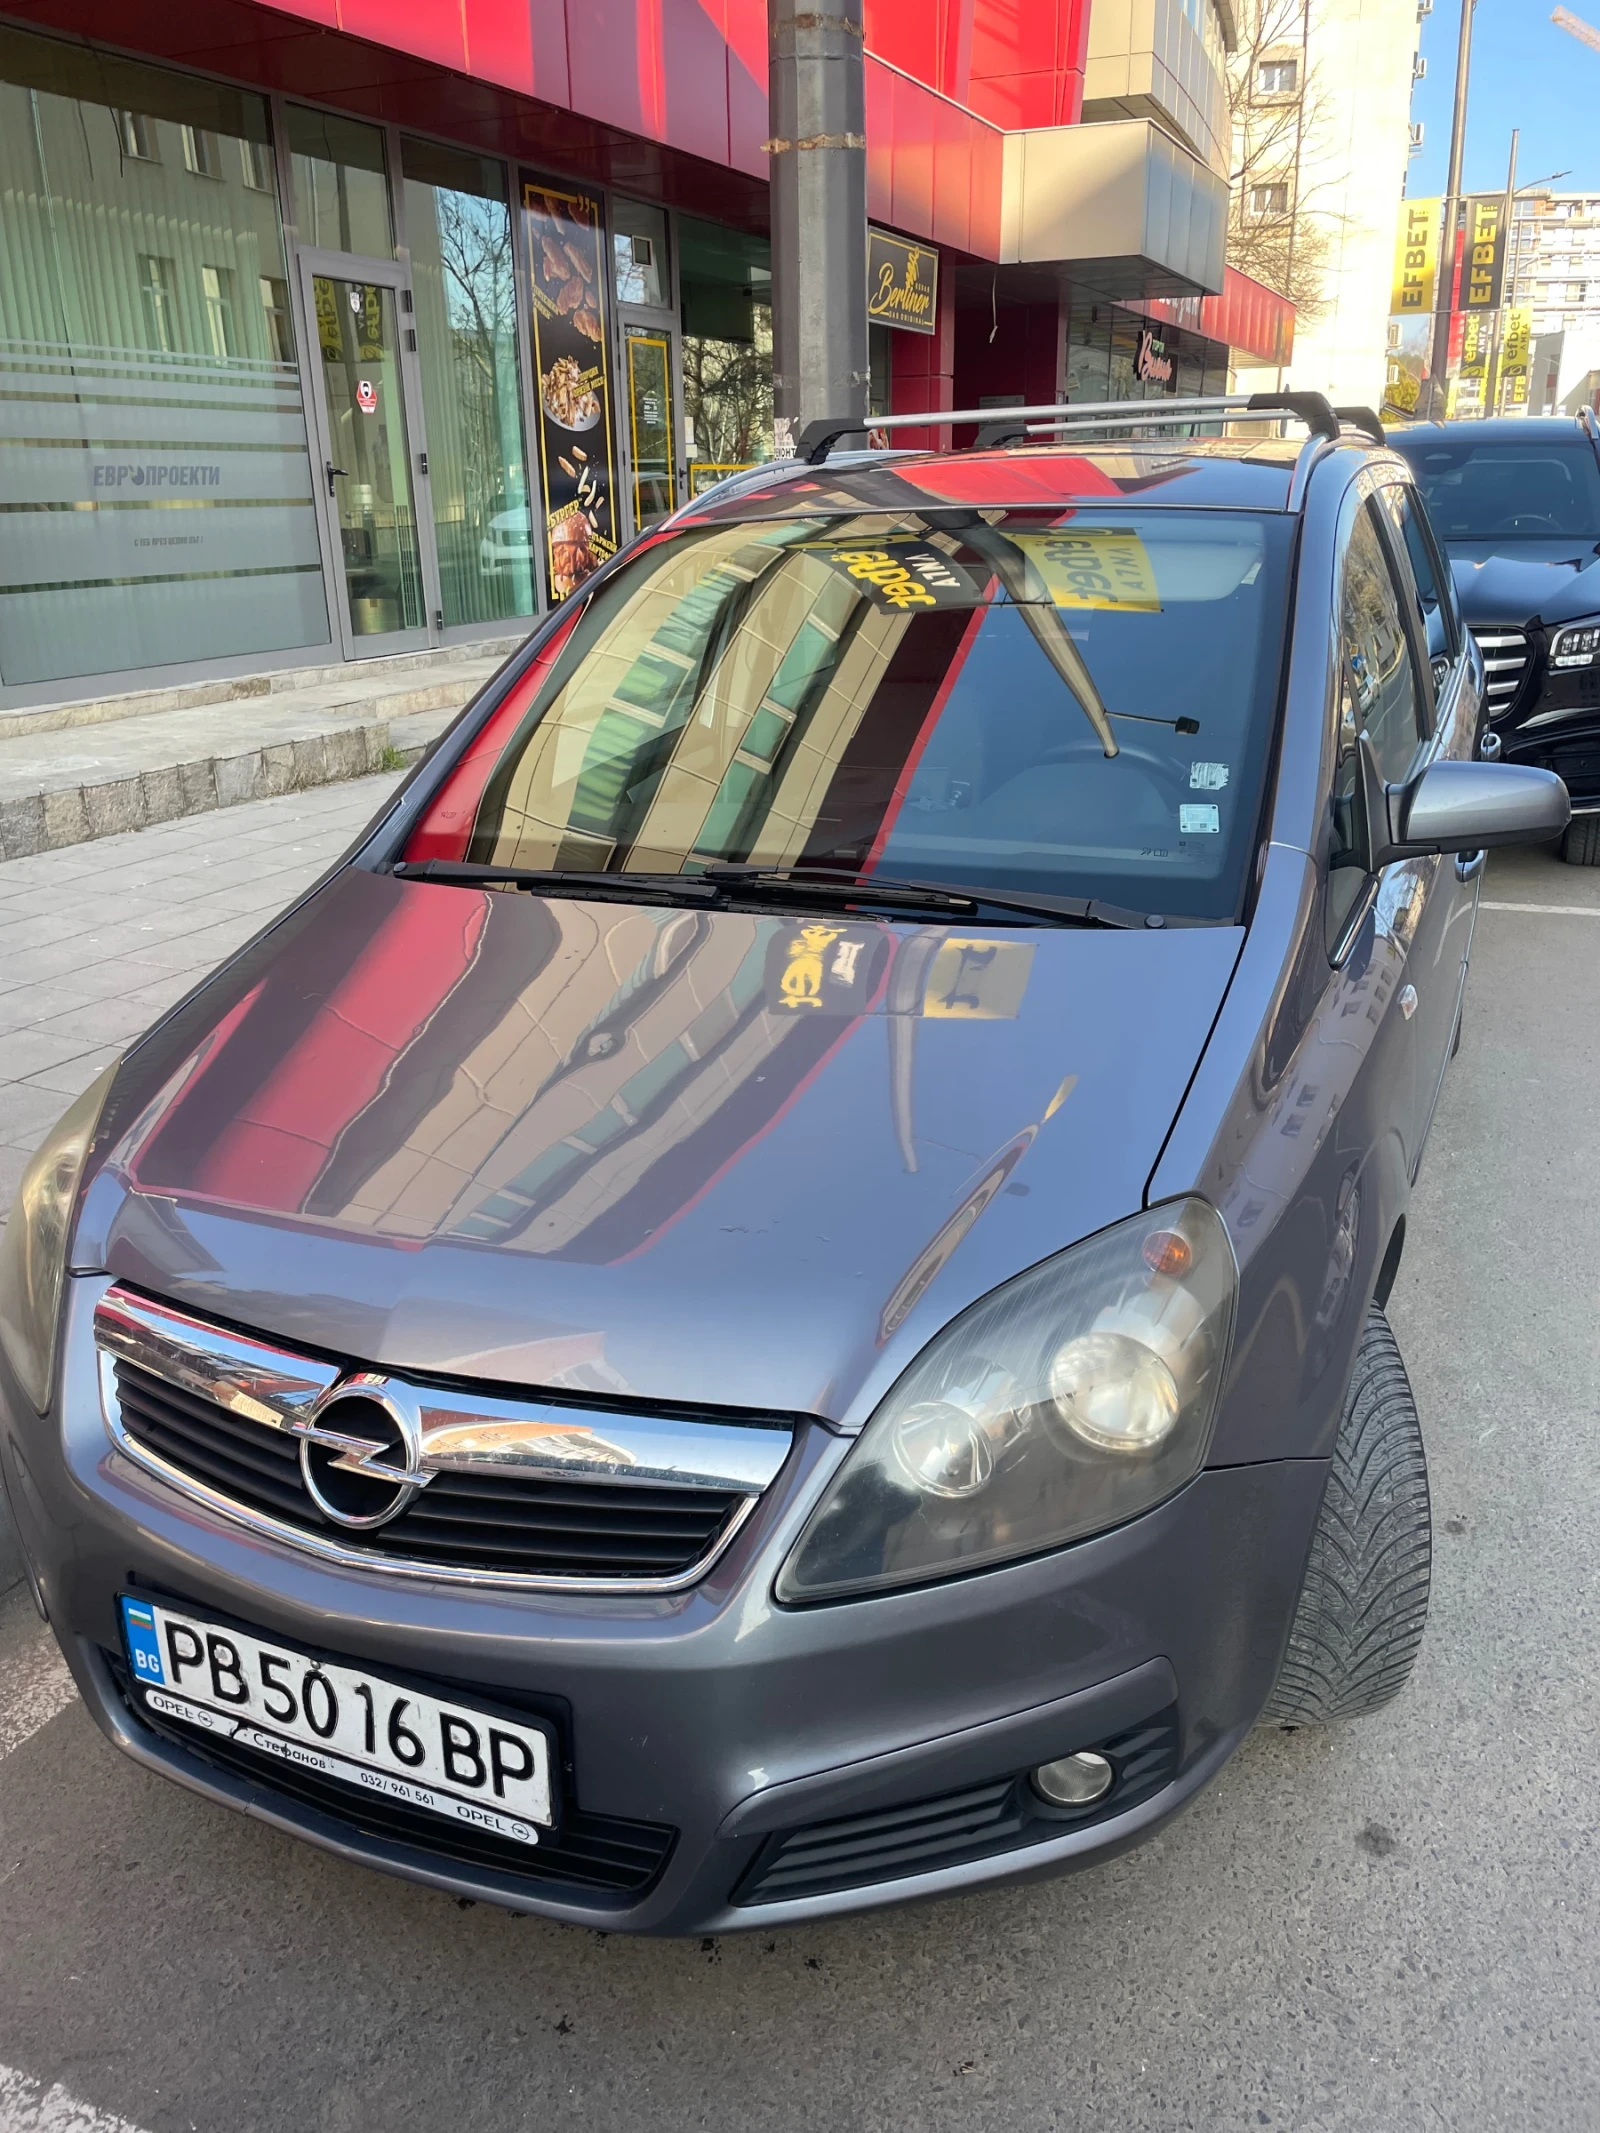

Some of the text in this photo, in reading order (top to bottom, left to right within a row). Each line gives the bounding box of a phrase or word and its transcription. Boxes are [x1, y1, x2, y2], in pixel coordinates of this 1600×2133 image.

[1402, 208, 1429, 308] EFBET
[1468, 202, 1498, 304] EFBET
[868, 262, 930, 315] Berliner
[1464, 315, 1480, 363] efbet
[1506, 313, 1521, 361] efbet
[93, 464, 220, 487] ЕВРОПРОЕКТИ
[135, 1648, 160, 1674] BG
[163, 1619, 535, 1799] PB 5016 BP
[153, 1695, 194, 1720] OPEL
[360, 1772, 387, 1791] 032/
[391, 1781, 411, 1799] 961
[415, 1789, 435, 1806] 561
[457, 1805, 507, 1832] OPEL
